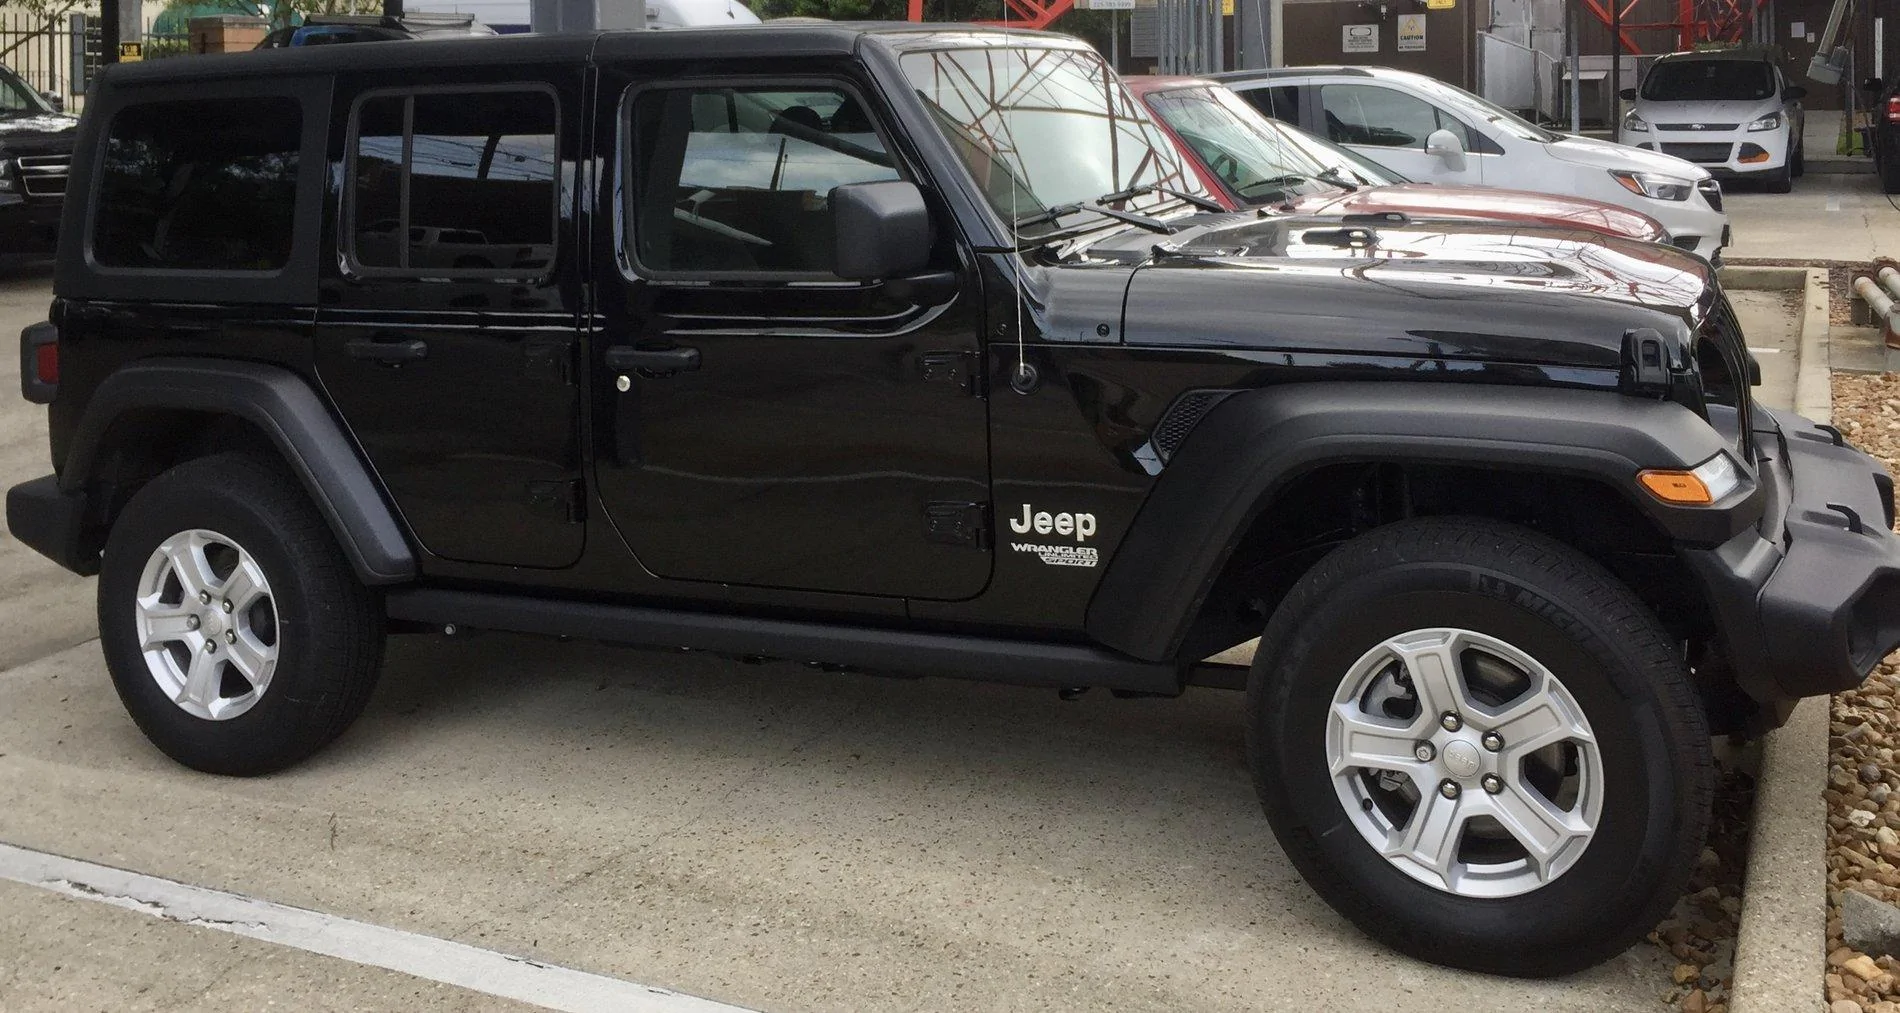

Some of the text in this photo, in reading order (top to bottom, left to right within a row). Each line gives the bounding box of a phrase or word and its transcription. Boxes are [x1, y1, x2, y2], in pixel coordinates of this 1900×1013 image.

[1010, 504, 1096, 541] Jeep
[1011, 542, 1098, 556] WRANGLER
[1042, 557, 1097, 567] SPORT
